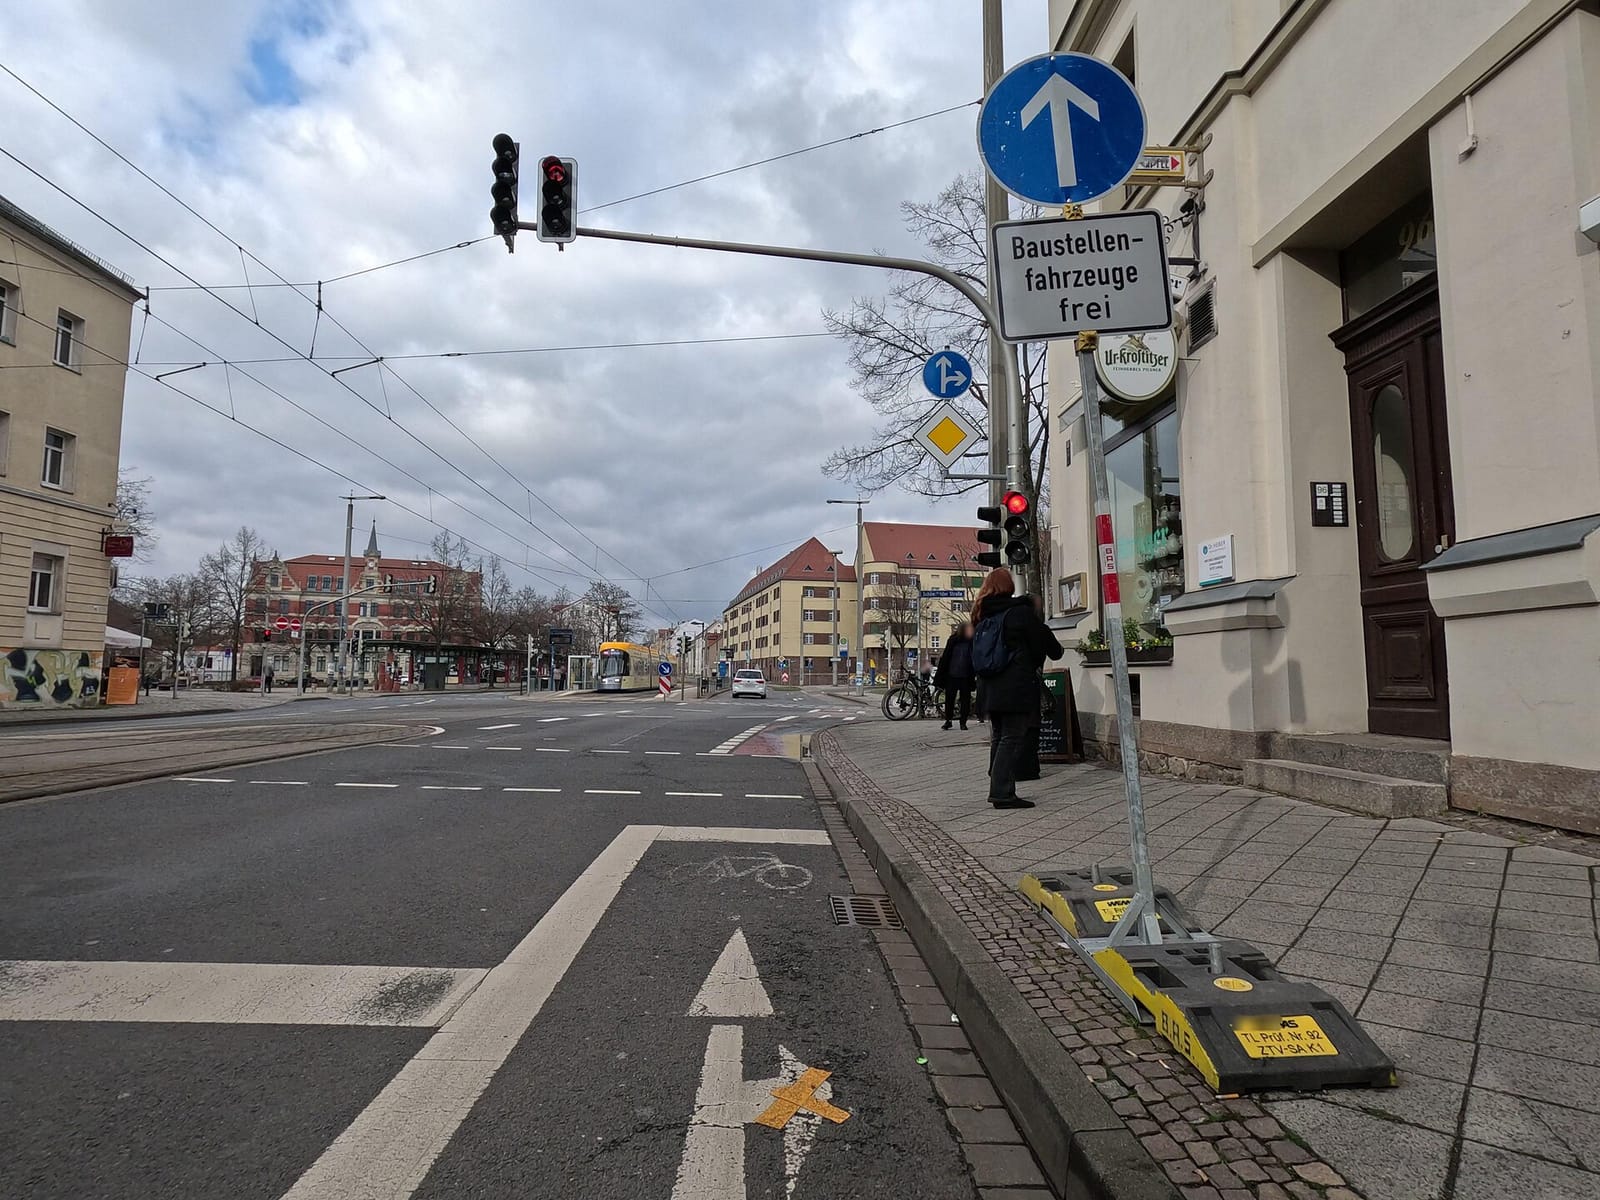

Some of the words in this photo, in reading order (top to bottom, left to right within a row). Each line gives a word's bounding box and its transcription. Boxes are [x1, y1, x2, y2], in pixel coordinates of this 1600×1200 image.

[1012, 229, 1144, 260] Baustellen-
[1025, 265, 1138, 292] fahrzeuge
[1059, 294, 1112, 322] frei
[1241, 1033, 1260, 1043] TL
[1306, 1030, 1323, 1040] 92
[1257, 1044, 1306, 1056] ZTV-SA
